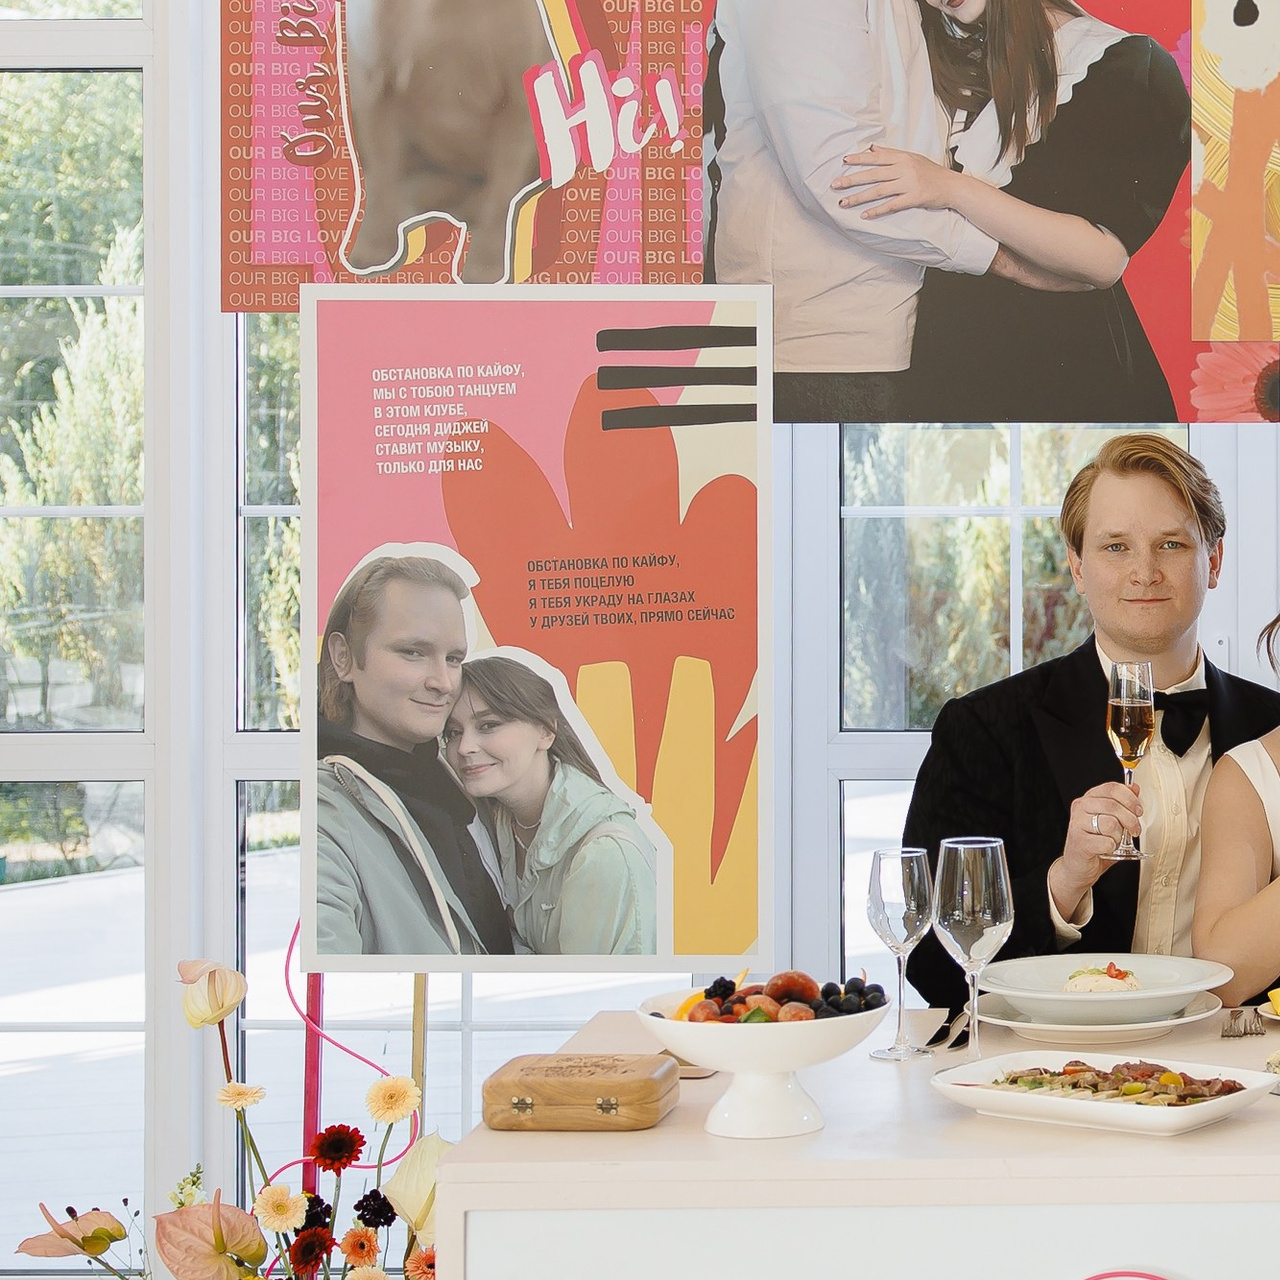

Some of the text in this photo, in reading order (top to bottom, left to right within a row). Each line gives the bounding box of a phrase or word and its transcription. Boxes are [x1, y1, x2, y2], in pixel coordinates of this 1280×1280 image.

[604, 0, 675, 12] OUR BIG
[229, 83, 299, 96] OUR BIG
[229, 104, 299, 117] OUR BIG
[281, 62, 334, 166] Our
[529, 54, 687, 189] Hi!
[229, 167, 675, 180] OUR BIG LOVE OUR BIG
[229, 188, 676, 201] OUR BIG LOVE OUR BIG
[229, 209, 676, 222] OUR BIG LOVE OUR BIG
[229, 230, 676, 243] OUR BIG OUR BIG
[229, 251, 675, 264] OUR BIG OUR BIG
[372, 362, 525, 382] ОБСТАНОВКА ПО КАЙФУ,
[373, 382, 517, 401] МЫ С ТОБОЮ ТАНЦУЕМ
[374, 403, 468, 419] В ЭТОМ КЛУБЕ,
[374, 419, 489, 438] СЕГОДНЯ ДИДЖЕЙ
[375, 440, 485, 456] СТАВИТ МУЗЫКУ,
[376, 458, 483, 474] ТОЛЬКО ДЛЯ НАС
[527, 553, 680, 573] ОБСТАНОВКА ПО КАЙФУ,
[527, 575, 635, 591] Я ТЕБЯ ПОЦЕЛУЮ
[529, 590, 696, 610] Я ТЕБЯ УКРАДУ НА ГЛАЗАХ
[530, 606, 735, 630] У ДРУЗЕЙ ТВОИХ, ПРЯМО СЕЙЧАС
